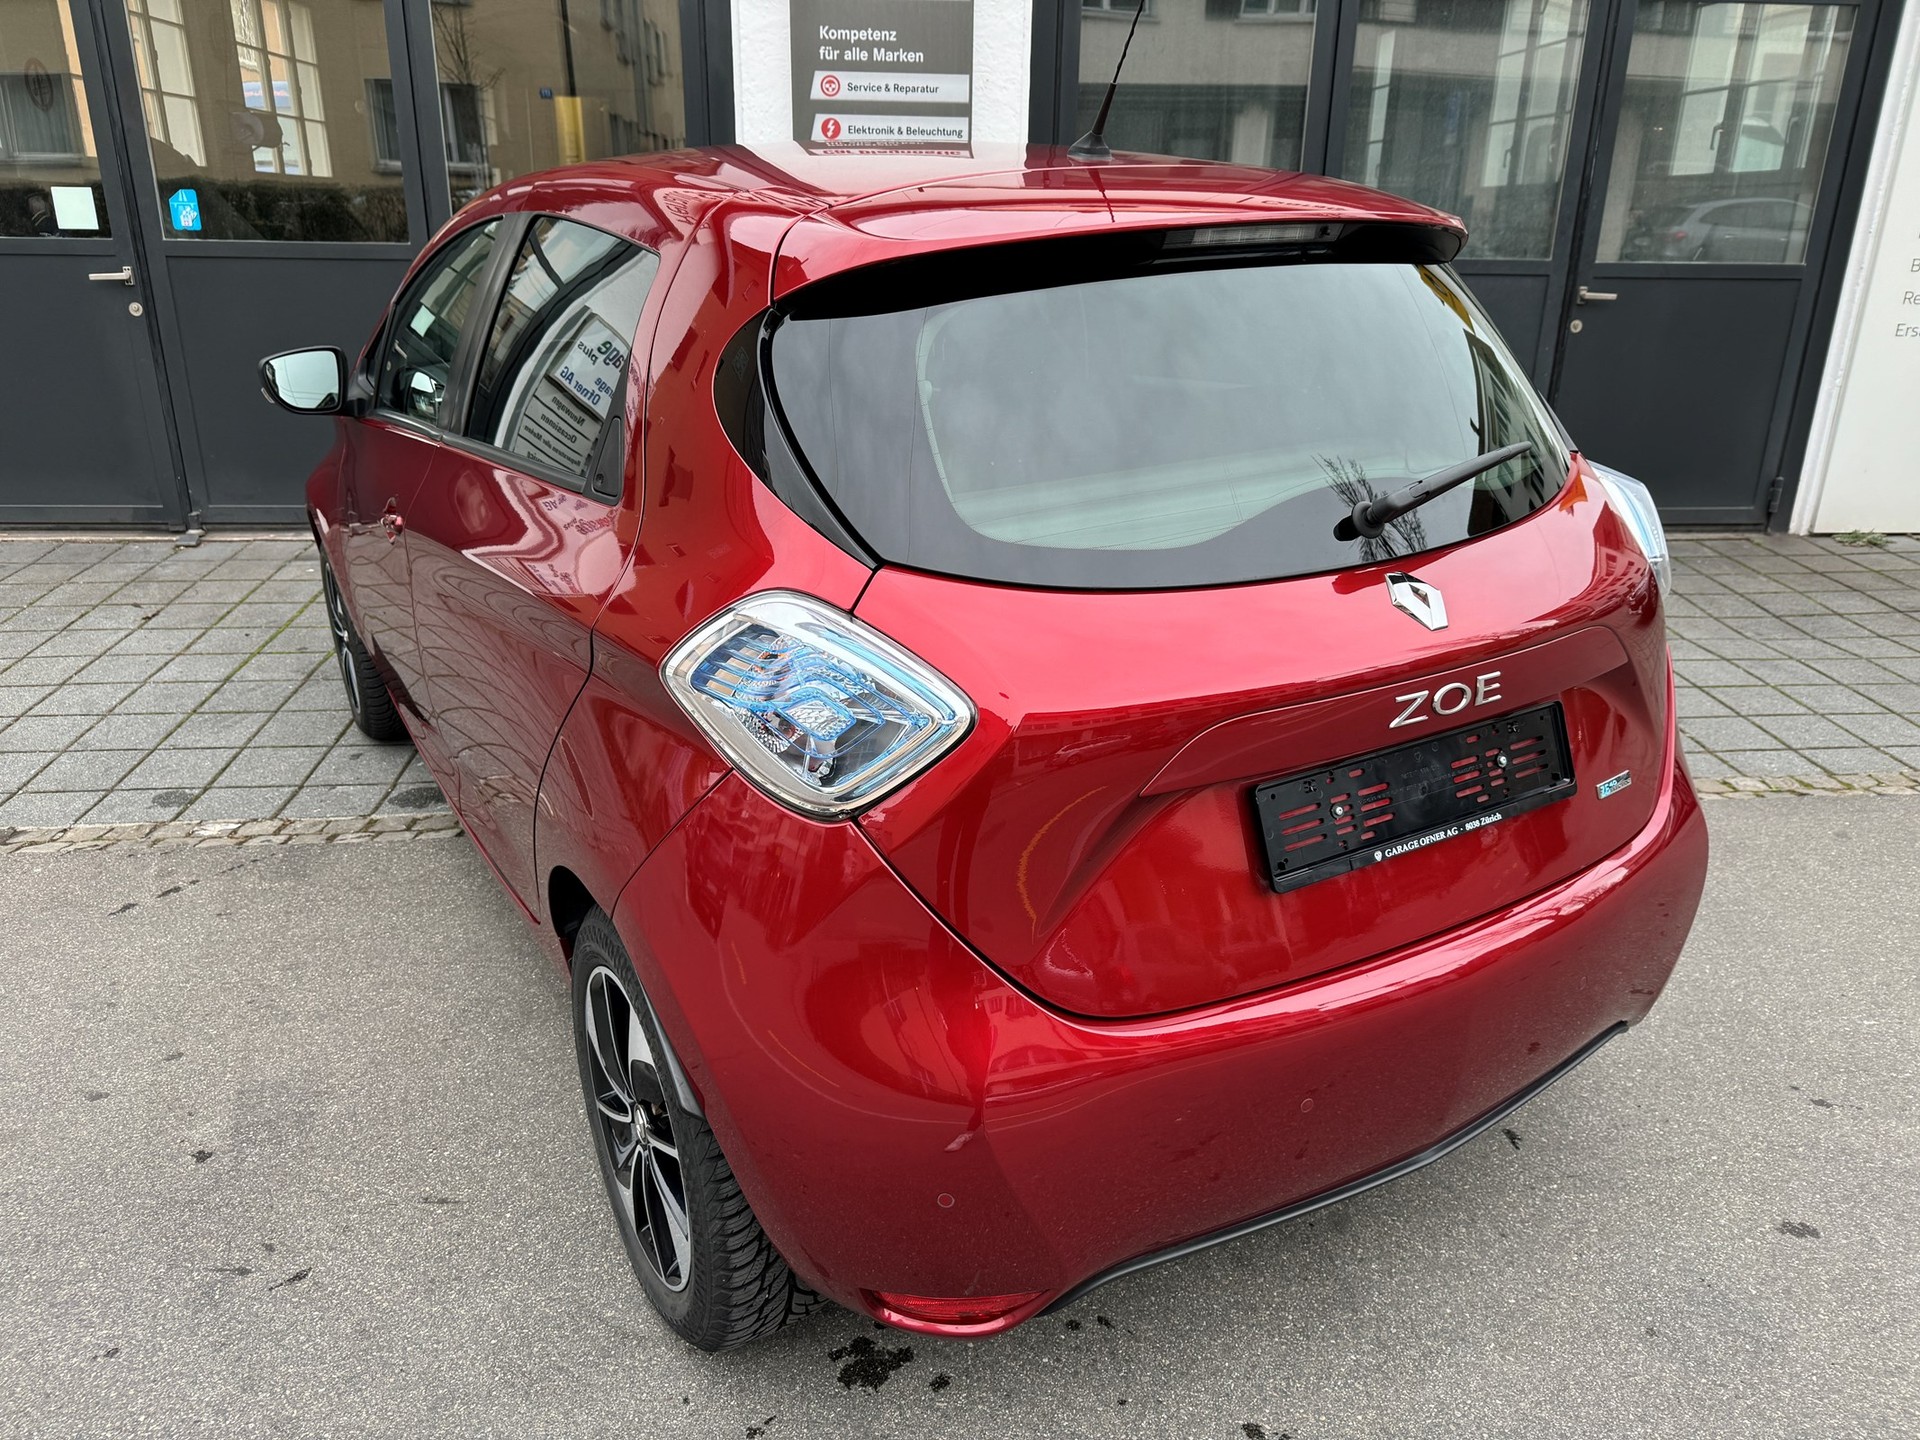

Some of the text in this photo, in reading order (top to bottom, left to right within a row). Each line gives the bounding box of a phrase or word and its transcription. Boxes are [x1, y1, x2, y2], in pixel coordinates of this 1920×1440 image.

[819, 25, 897, 43] Kompetenz
[819, 46, 924, 63] für alle Marken
[847, 82, 939, 95] Service & Reparatur
[848, 125, 963, 138] Elektronik & Beleuchtung
[1388, 671, 1502, 729] ZOE
[1385, 812, 1502, 857] GARAGE OFNER AG 8038 Zürich
